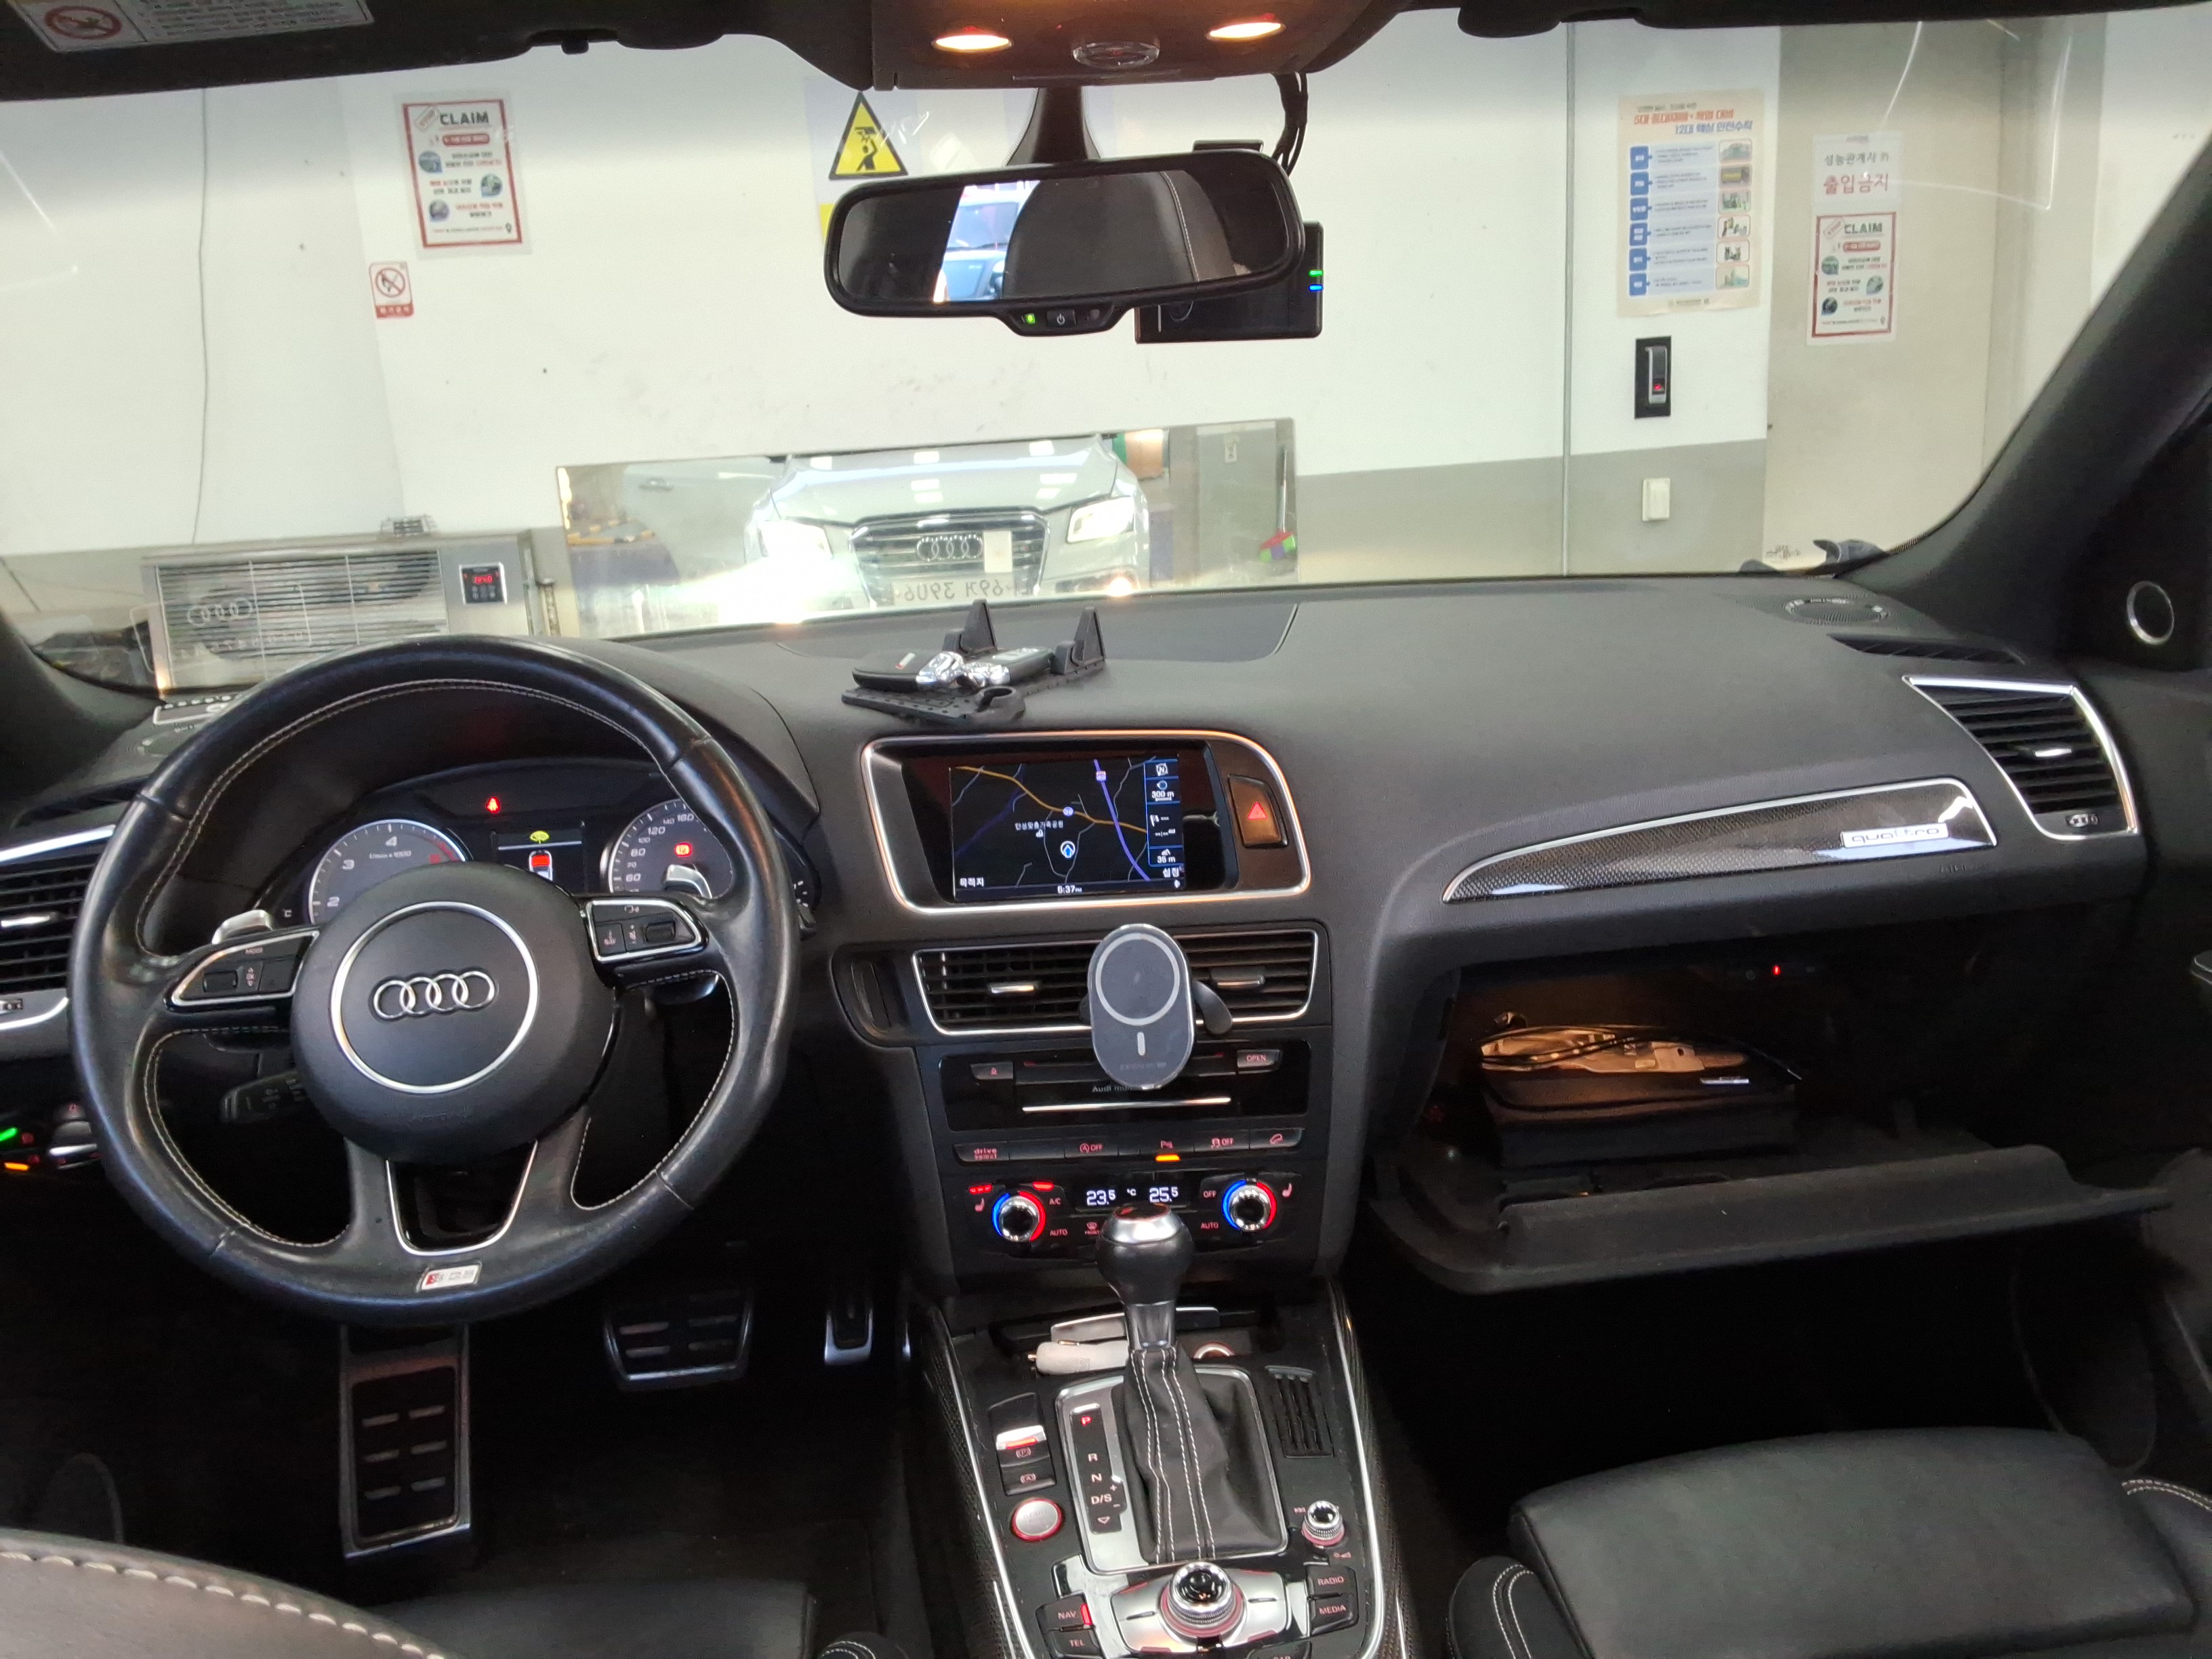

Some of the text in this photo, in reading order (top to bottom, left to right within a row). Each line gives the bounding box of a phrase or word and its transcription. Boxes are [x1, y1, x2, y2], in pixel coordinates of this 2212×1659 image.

[441, 110, 489, 125] CLAIM
[1824, 172, 1889, 194] 출입금지
[1844, 222, 1883, 234] CLAIM
[648, 826, 665, 835] 120
[385, 836, 398, 846] 4
[631, 848, 645, 857] 80
[342, 859, 354, 870] 3
[626, 874, 640, 882] 60
[327, 897, 340, 907] 2
[1222, 1138, 1234, 1146] OFF
[1090, 1144, 1103, 1152] OFF
[1086, 1189, 1116, 1206] 23.5
[1149, 1186, 1179, 1203] 25.5
[1050, 1229, 1068, 1237] AUTO
[1082, 1416, 1092, 1425] P
[1088, 1453, 1097, 1462] R
[1091, 1473, 1102, 1483] N
[1091, 1493, 1112, 1504] D/S
[1317, 1575, 1345, 1586] RADIO
[1319, 1604, 1347, 1615] MEDIA
[1057, 1610, 1076, 1620] NAV
[1069, 1639, 1086, 1647] TEL
